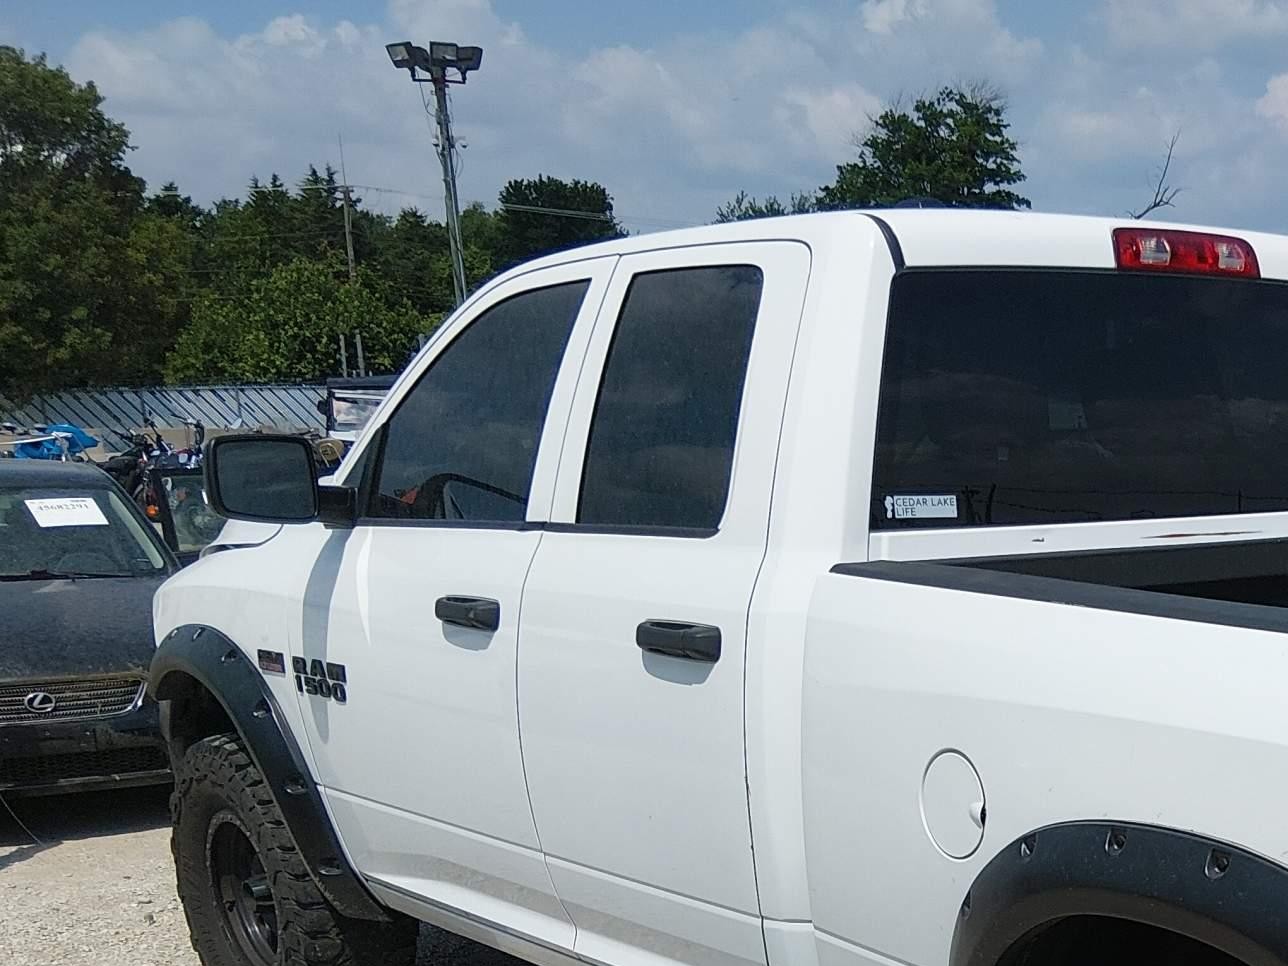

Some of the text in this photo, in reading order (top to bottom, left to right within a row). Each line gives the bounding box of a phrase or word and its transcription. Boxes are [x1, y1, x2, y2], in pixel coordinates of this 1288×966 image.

[895, 497, 955, 507] CEDAR LAKE
[895, 507, 917, 517] LIFE
[292, 656, 347, 683] RAM
[295, 674, 347, 702] 1500
